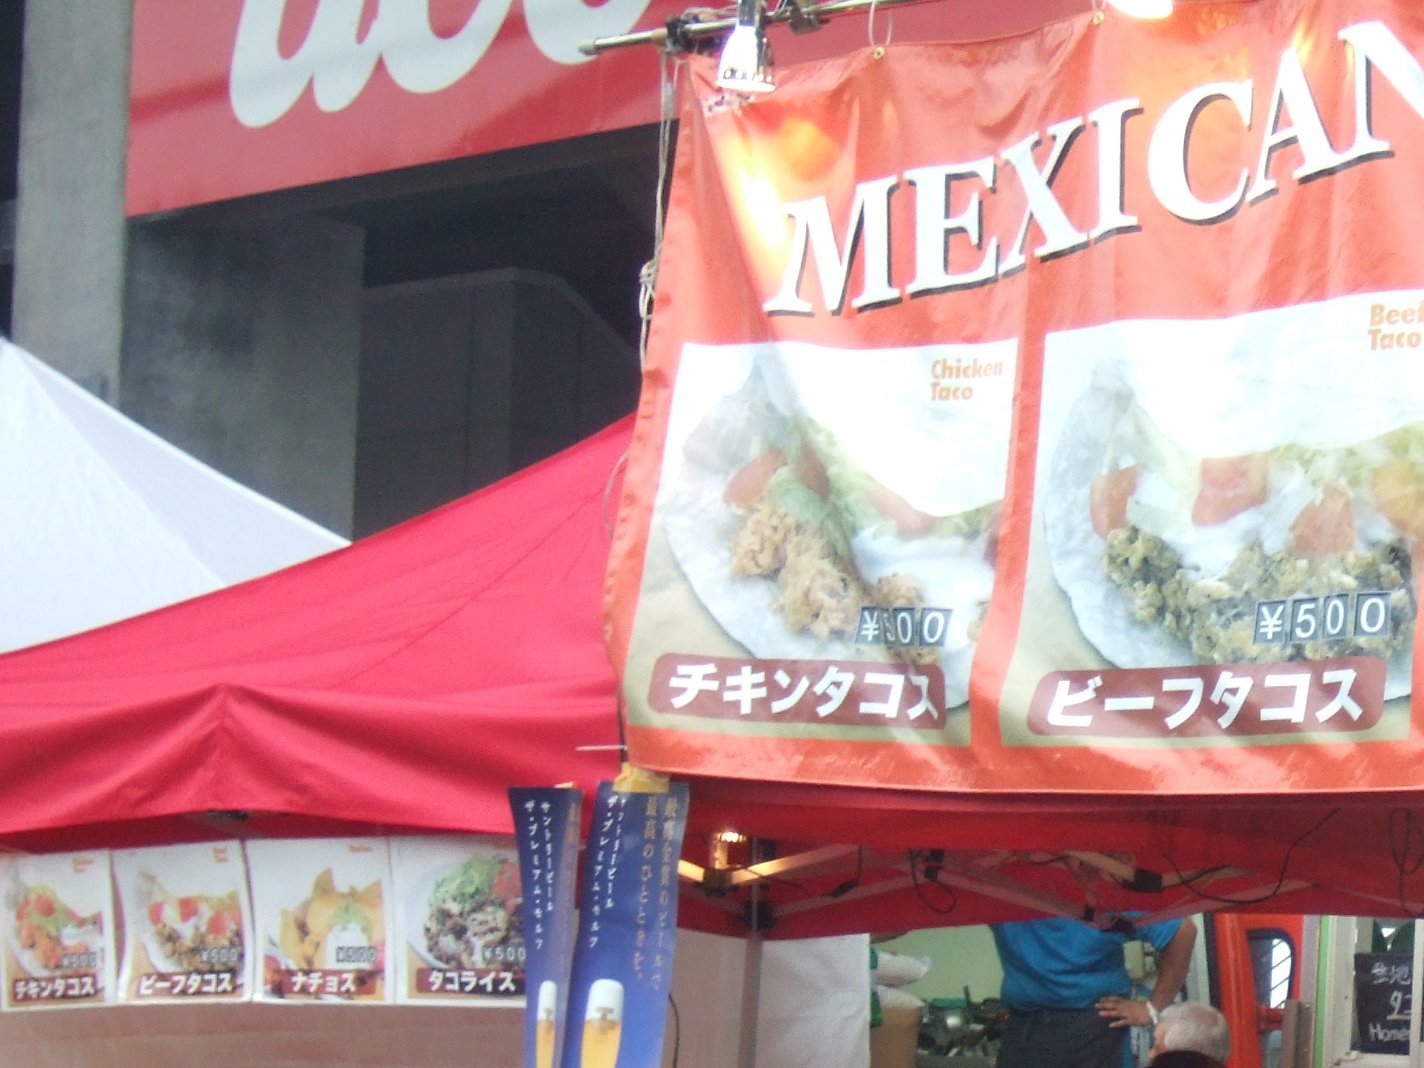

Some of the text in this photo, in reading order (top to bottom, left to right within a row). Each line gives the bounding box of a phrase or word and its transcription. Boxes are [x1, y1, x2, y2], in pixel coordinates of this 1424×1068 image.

[1368, 328, 1423, 350] Taco
[930, 357, 1004, 380] Chicken
[930, 381, 974, 401] Taco
[1256, 596, 1387, 641] ¥500
[668, 660, 940, 721] チキンタコス
[1046, 668, 1364, 730] ビーフタコス
[291, 971, 358, 993] ナチョス
[428, 971, 517, 993] タコライス
